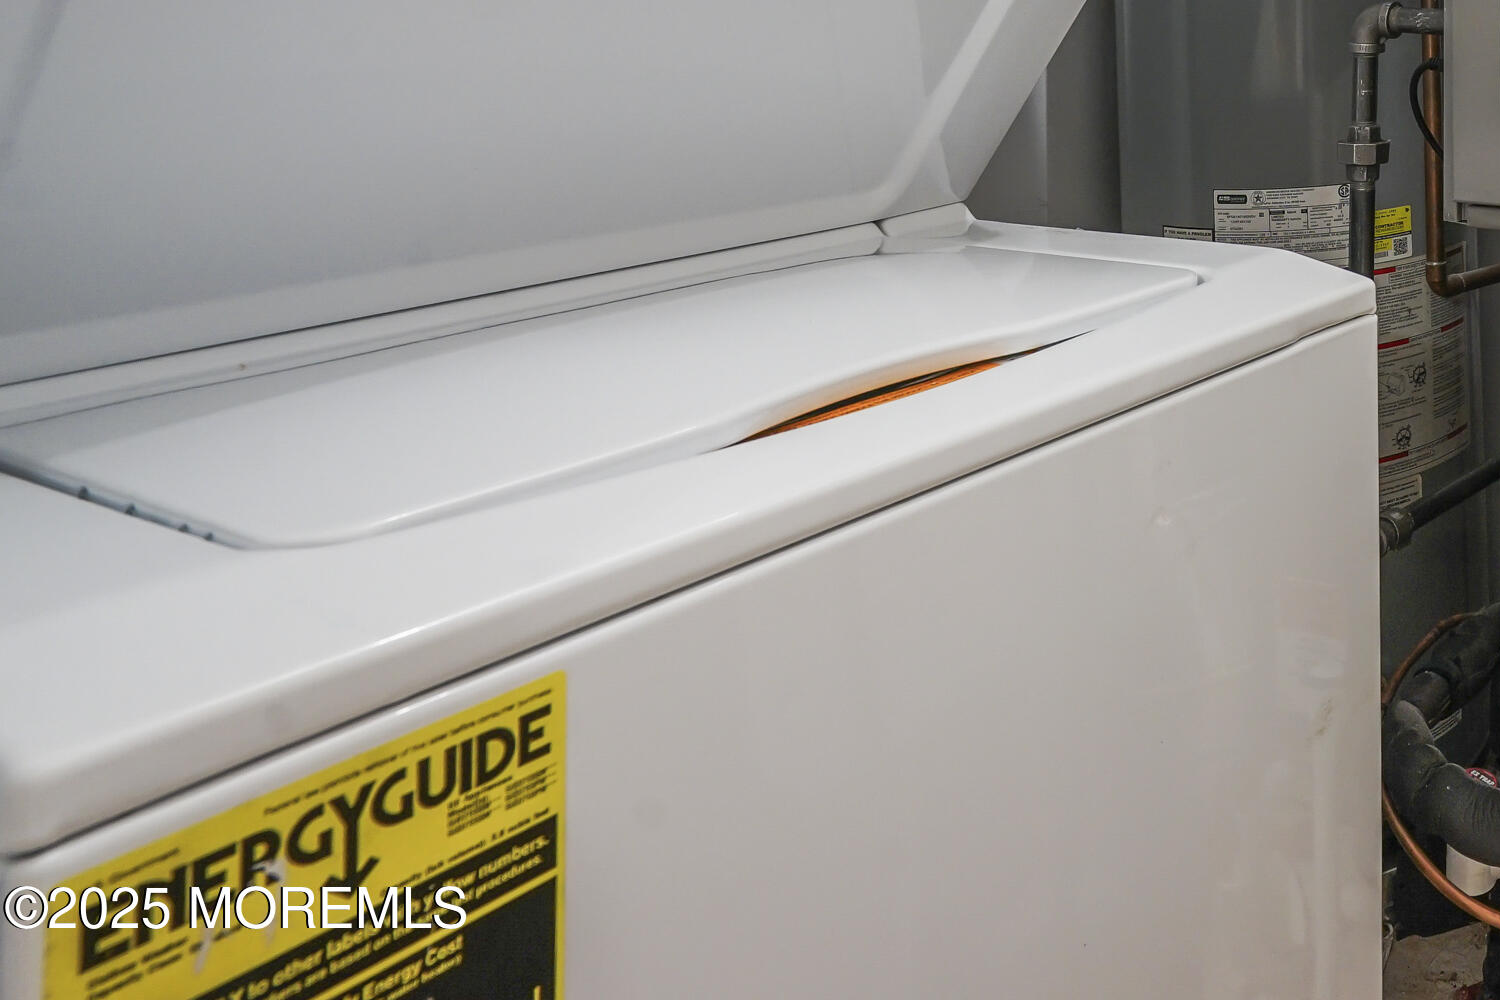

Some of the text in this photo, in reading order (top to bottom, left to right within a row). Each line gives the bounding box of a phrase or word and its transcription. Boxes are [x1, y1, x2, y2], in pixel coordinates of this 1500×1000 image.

[272, 948, 323, 987] other
[479, 834, 550, 879] numbers.
[362, 933, 464, 1000] Energy Cost
